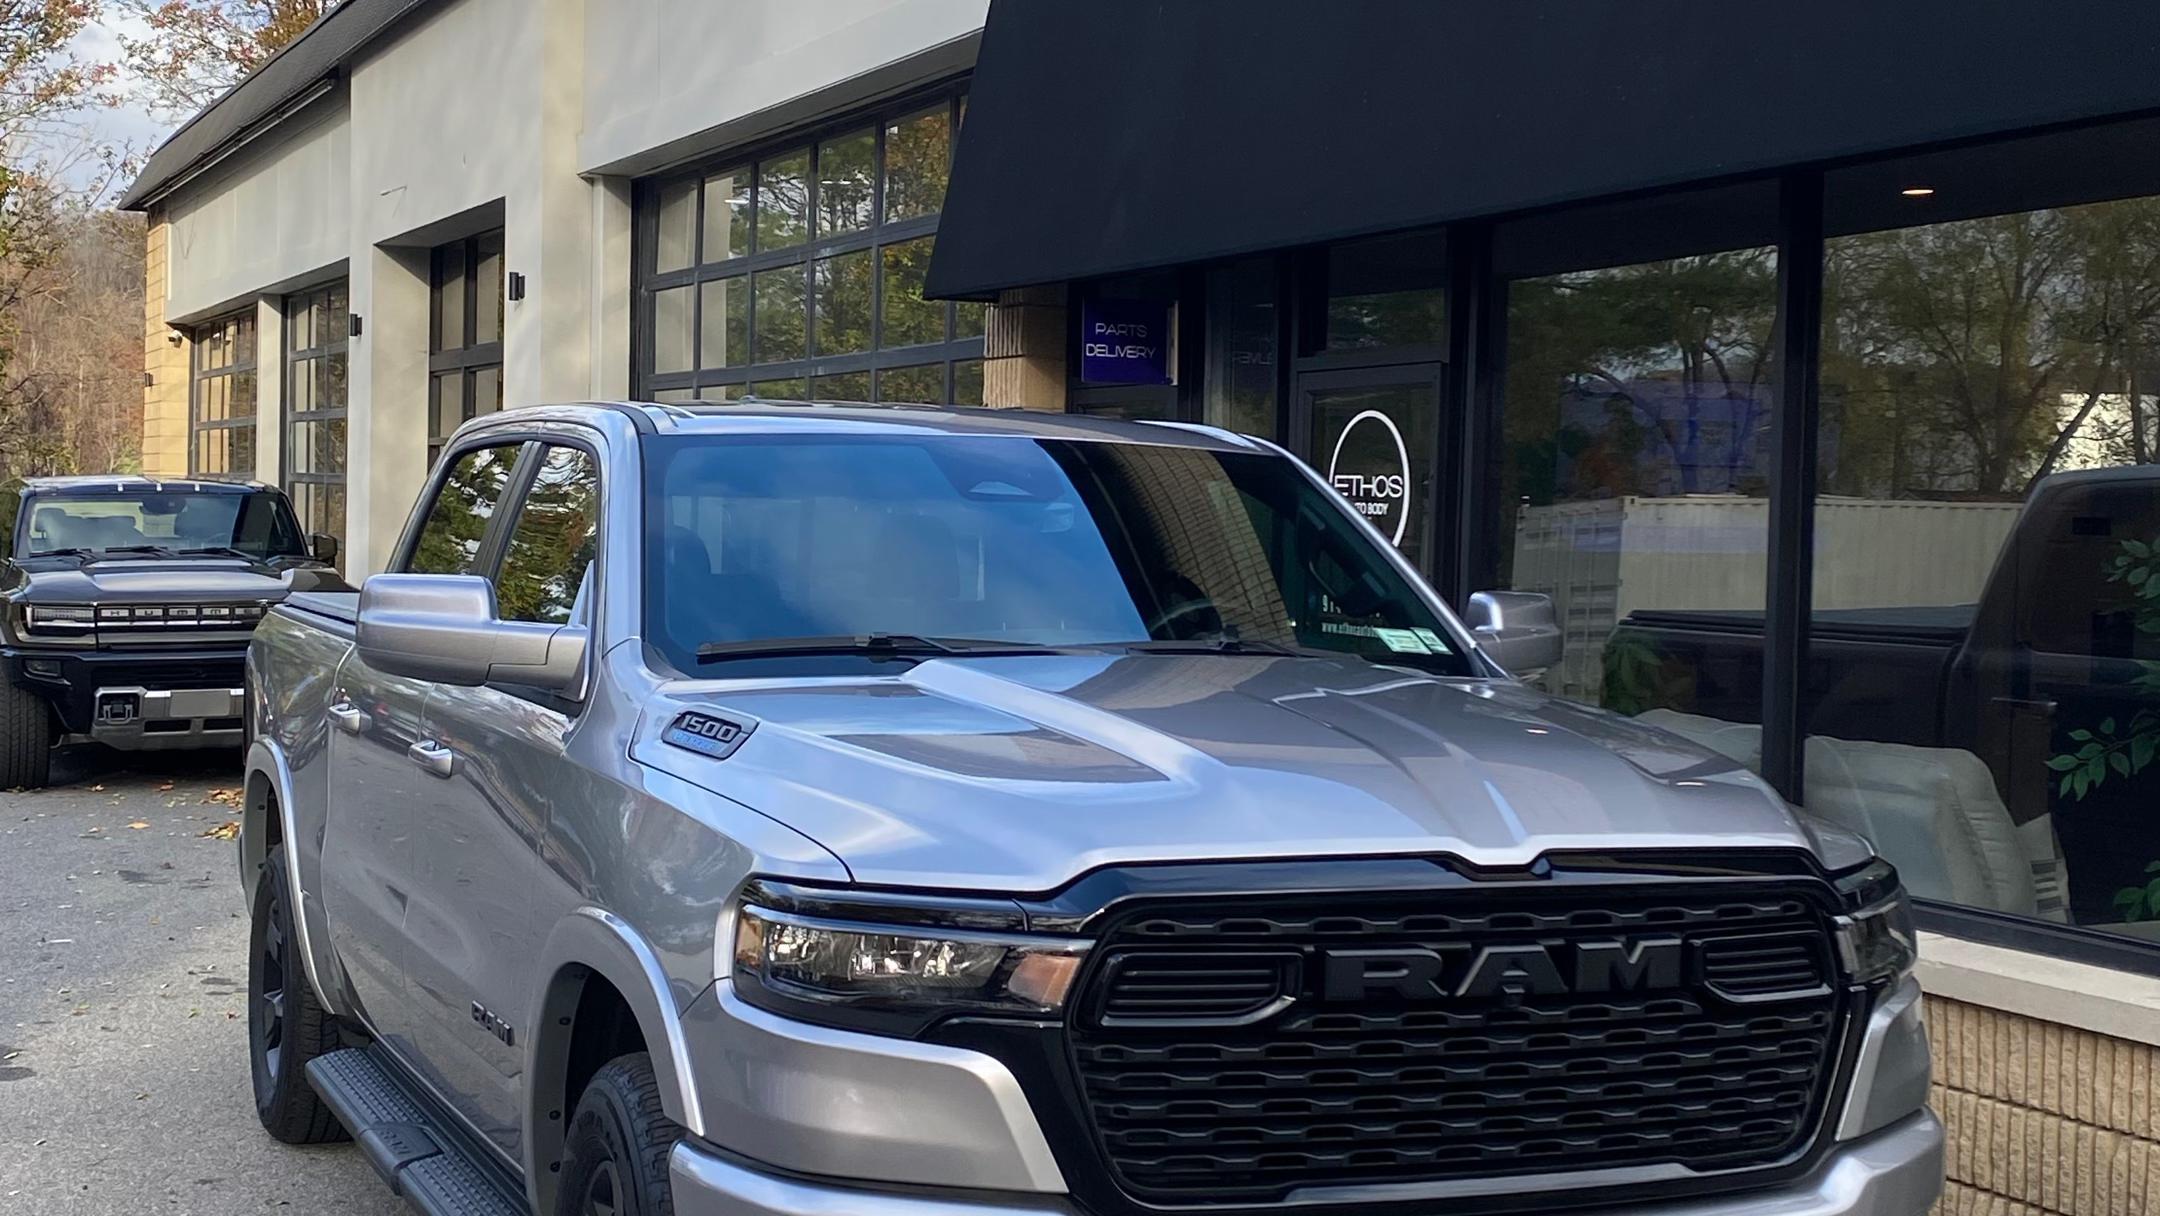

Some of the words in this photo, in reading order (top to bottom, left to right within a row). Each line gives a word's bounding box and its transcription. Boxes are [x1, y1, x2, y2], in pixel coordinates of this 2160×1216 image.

[1095, 322, 1148, 338] PARTS
[1085, 343, 1157, 359] DELIVERY
[1334, 474, 1403, 498] ETHOS
[1367, 502, 1390, 515] BODY
[679, 713, 738, 742] 1500
[1324, 937, 1683, 1001] RAM
[471, 999, 516, 1047] RAM
